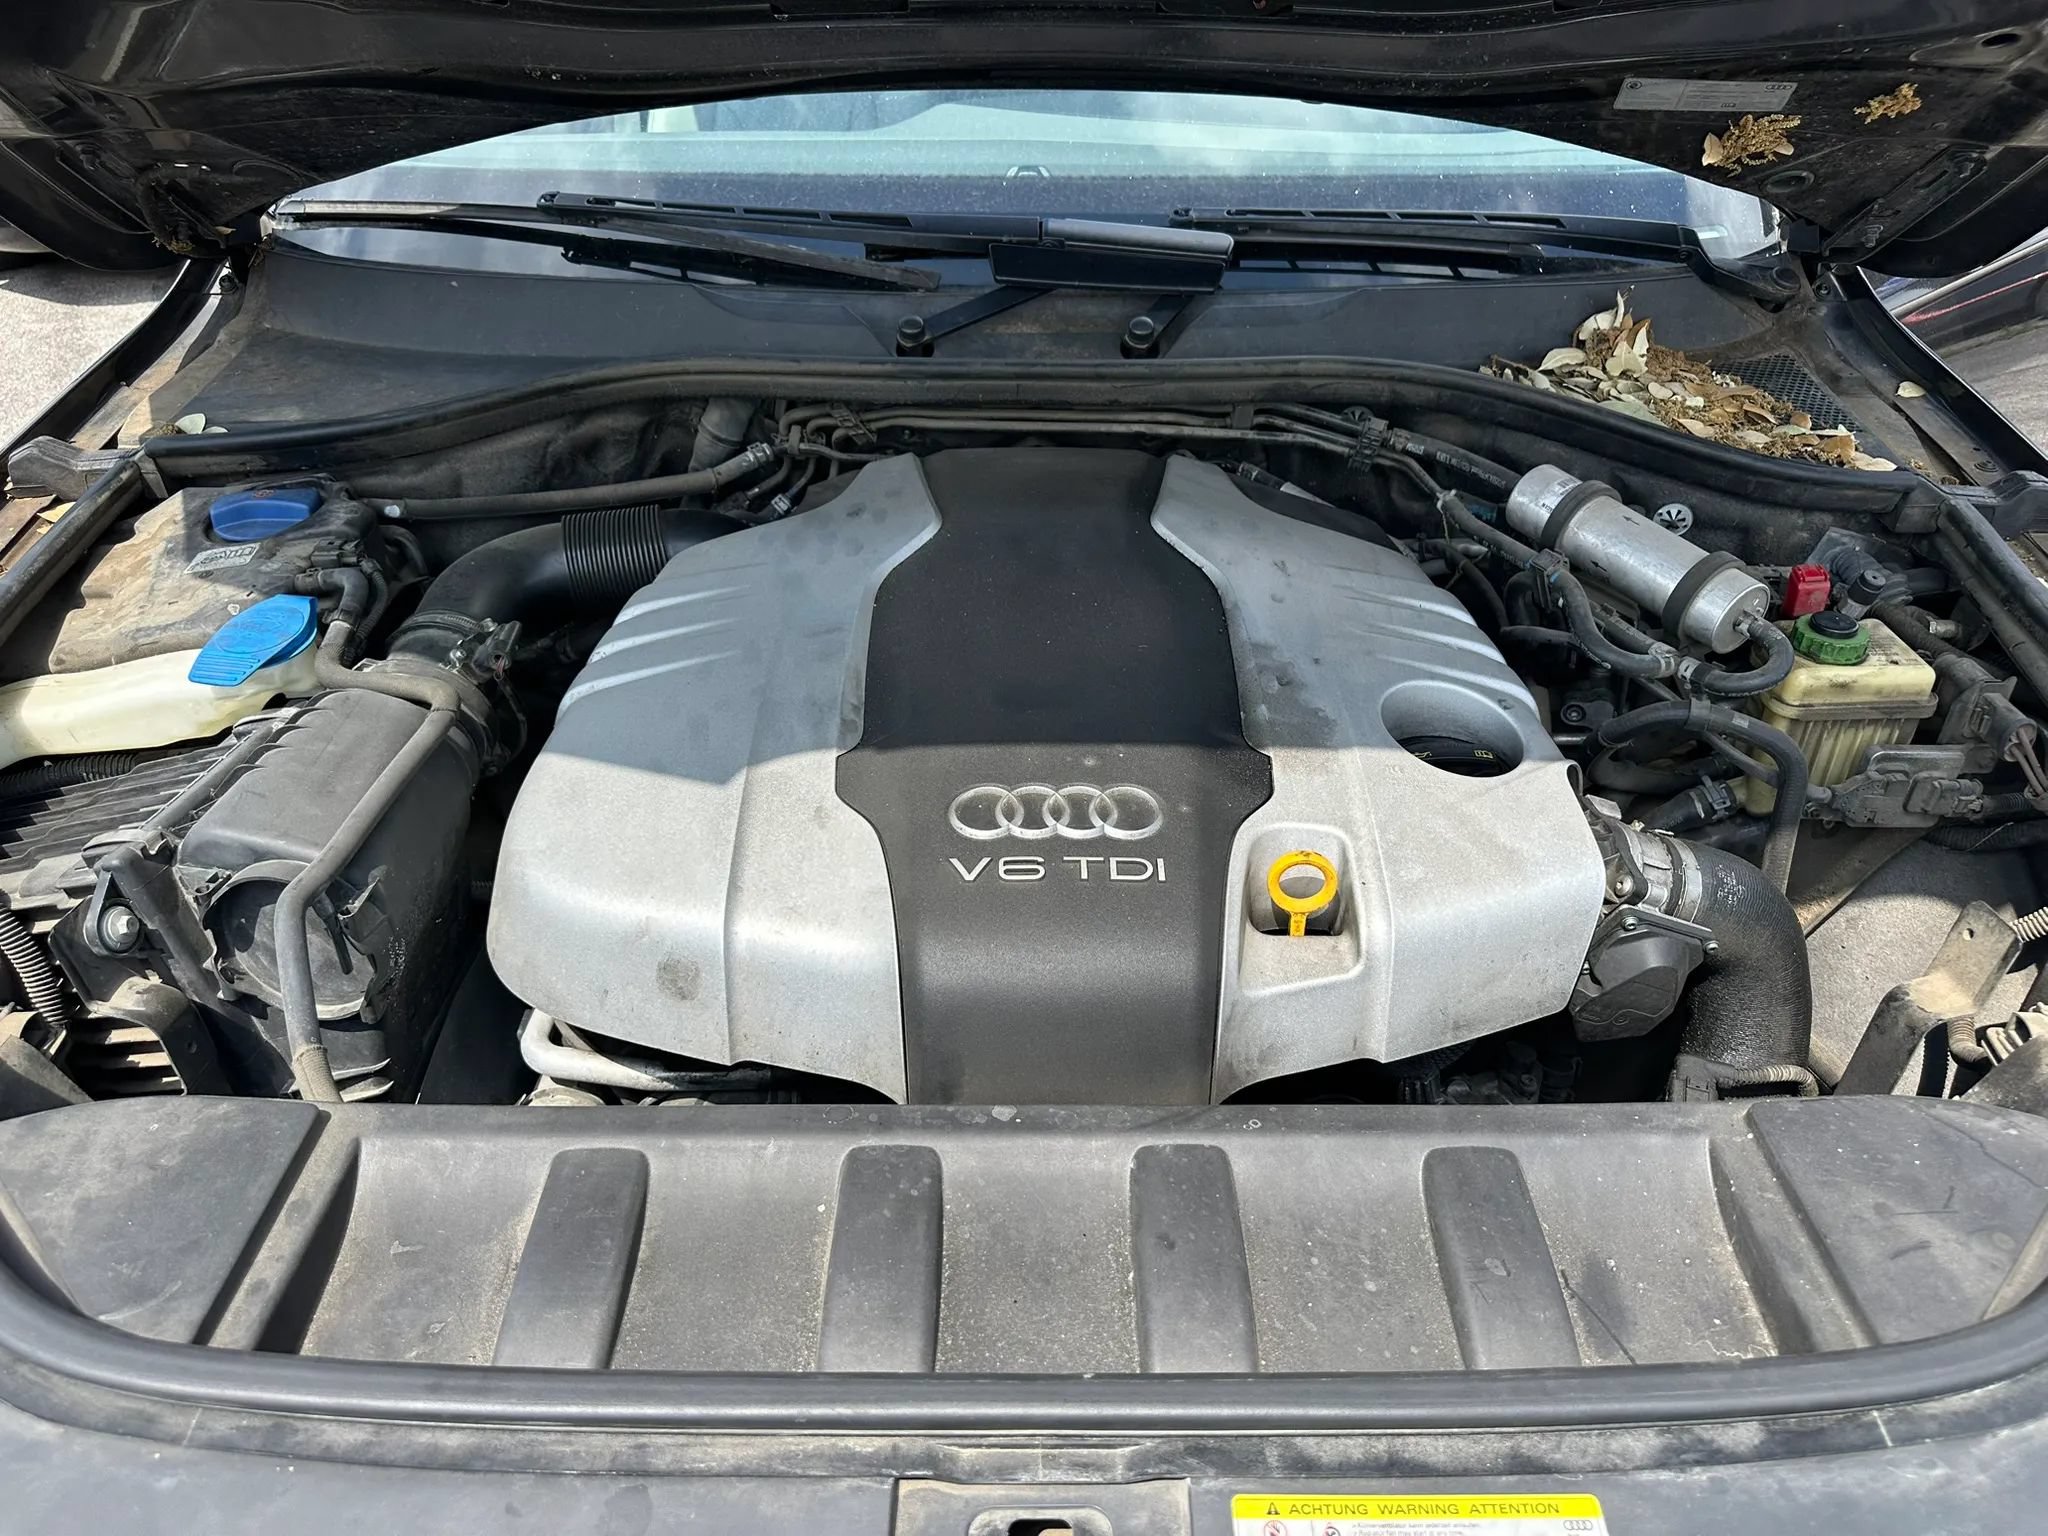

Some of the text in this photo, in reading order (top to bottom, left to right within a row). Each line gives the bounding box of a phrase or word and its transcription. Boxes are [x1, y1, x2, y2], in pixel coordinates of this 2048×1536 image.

[949, 856, 1167, 882] V6 TDI
[1289, 1502, 1560, 1515] ACHTUNG WARNING ATTENTION
